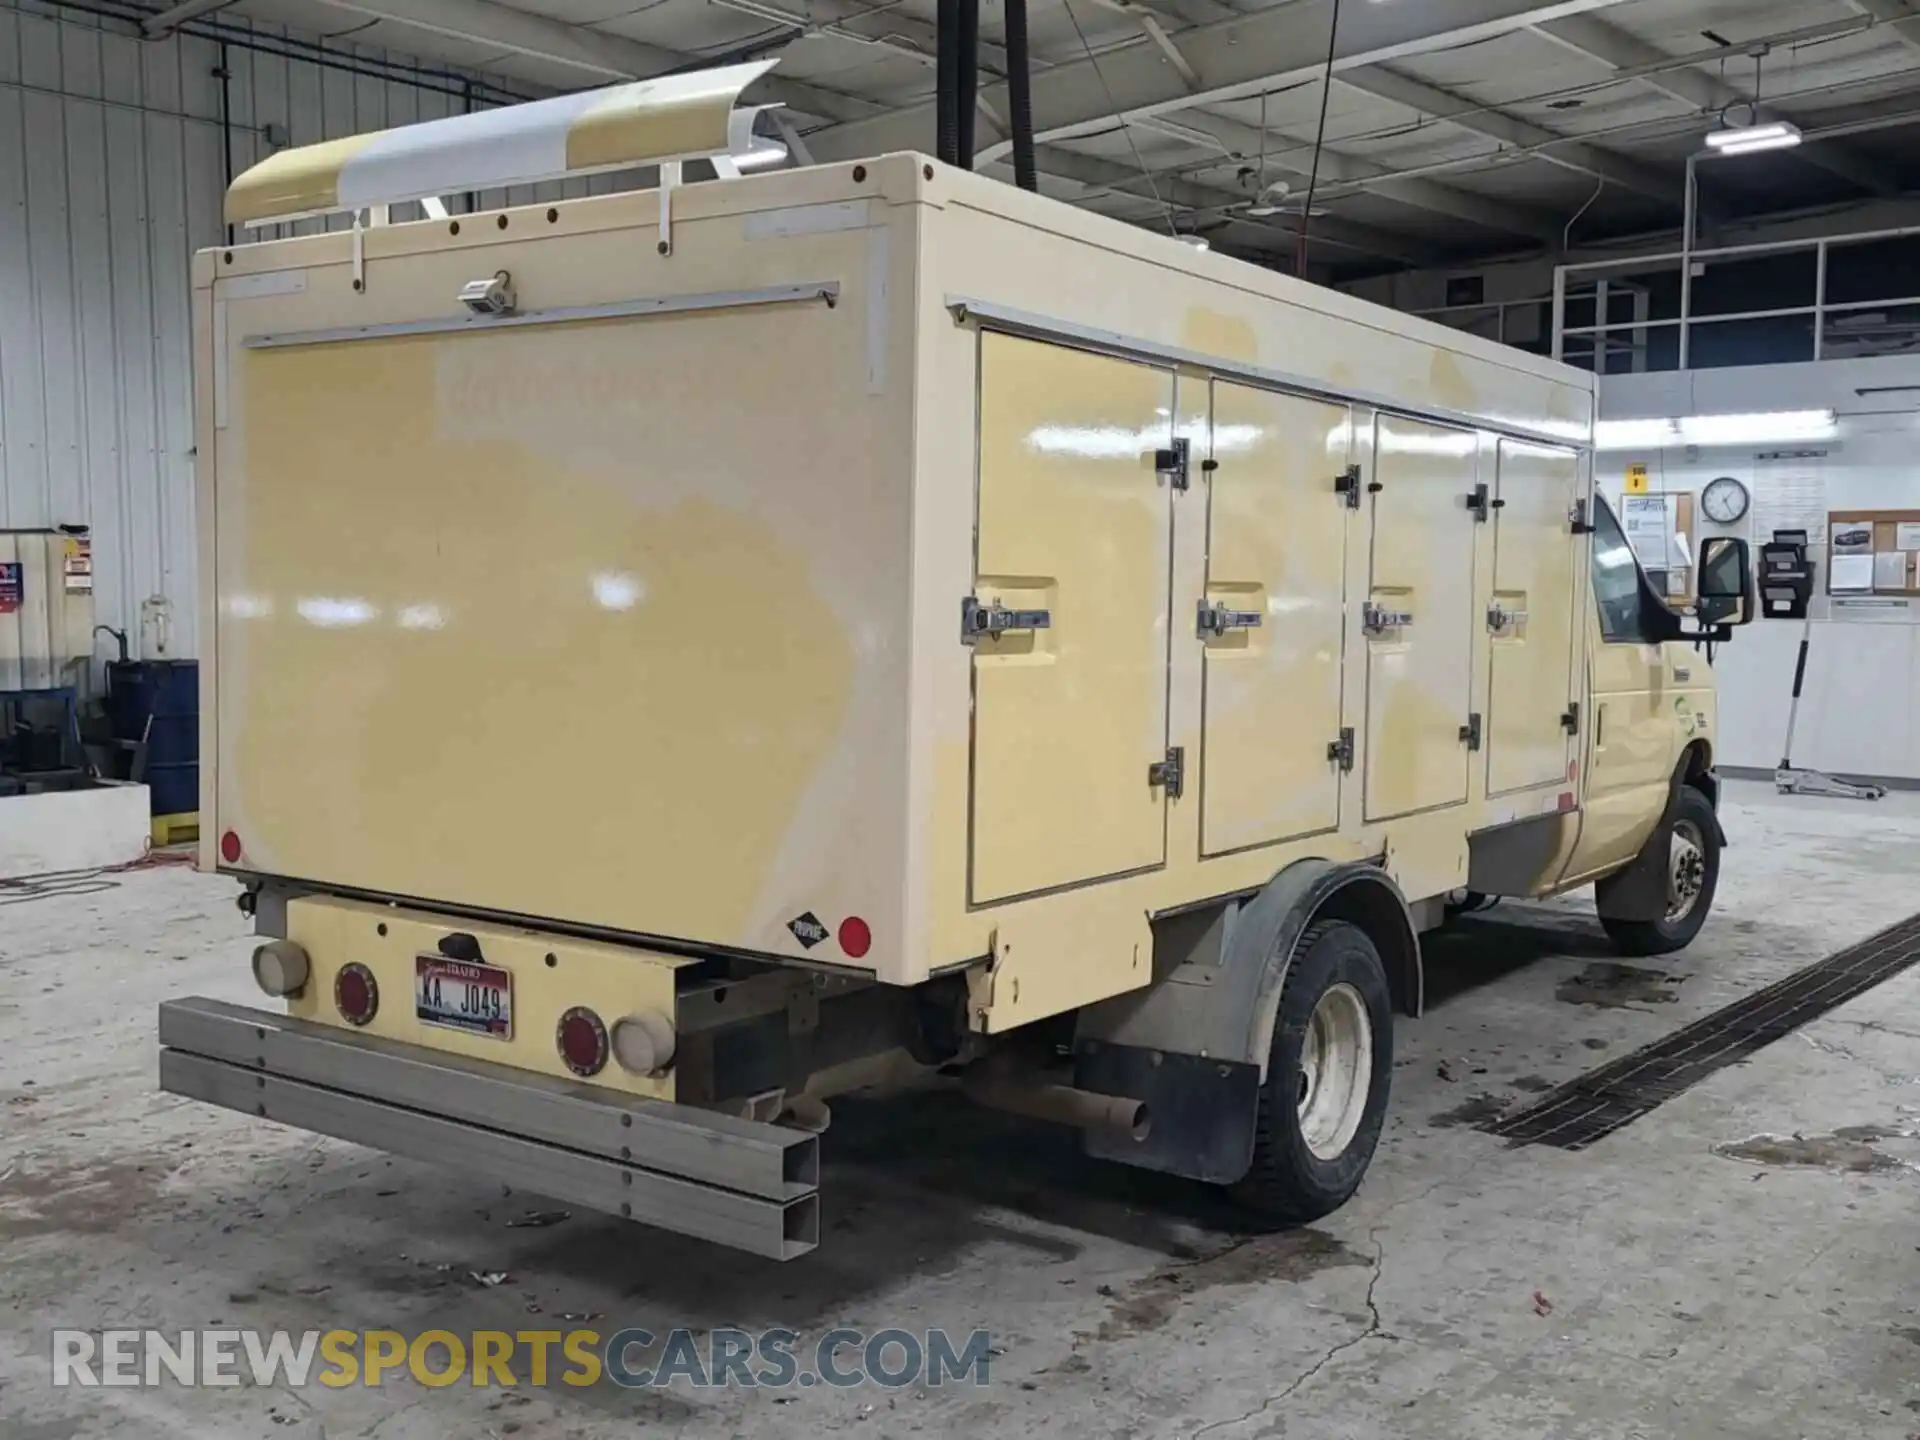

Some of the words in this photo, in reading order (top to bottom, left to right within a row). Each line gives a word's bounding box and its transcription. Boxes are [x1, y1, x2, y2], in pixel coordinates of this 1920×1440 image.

[446, 964, 481, 979] IDAHO
[423, 973, 442, 1008] KA
[461, 984, 501, 1018] J049
